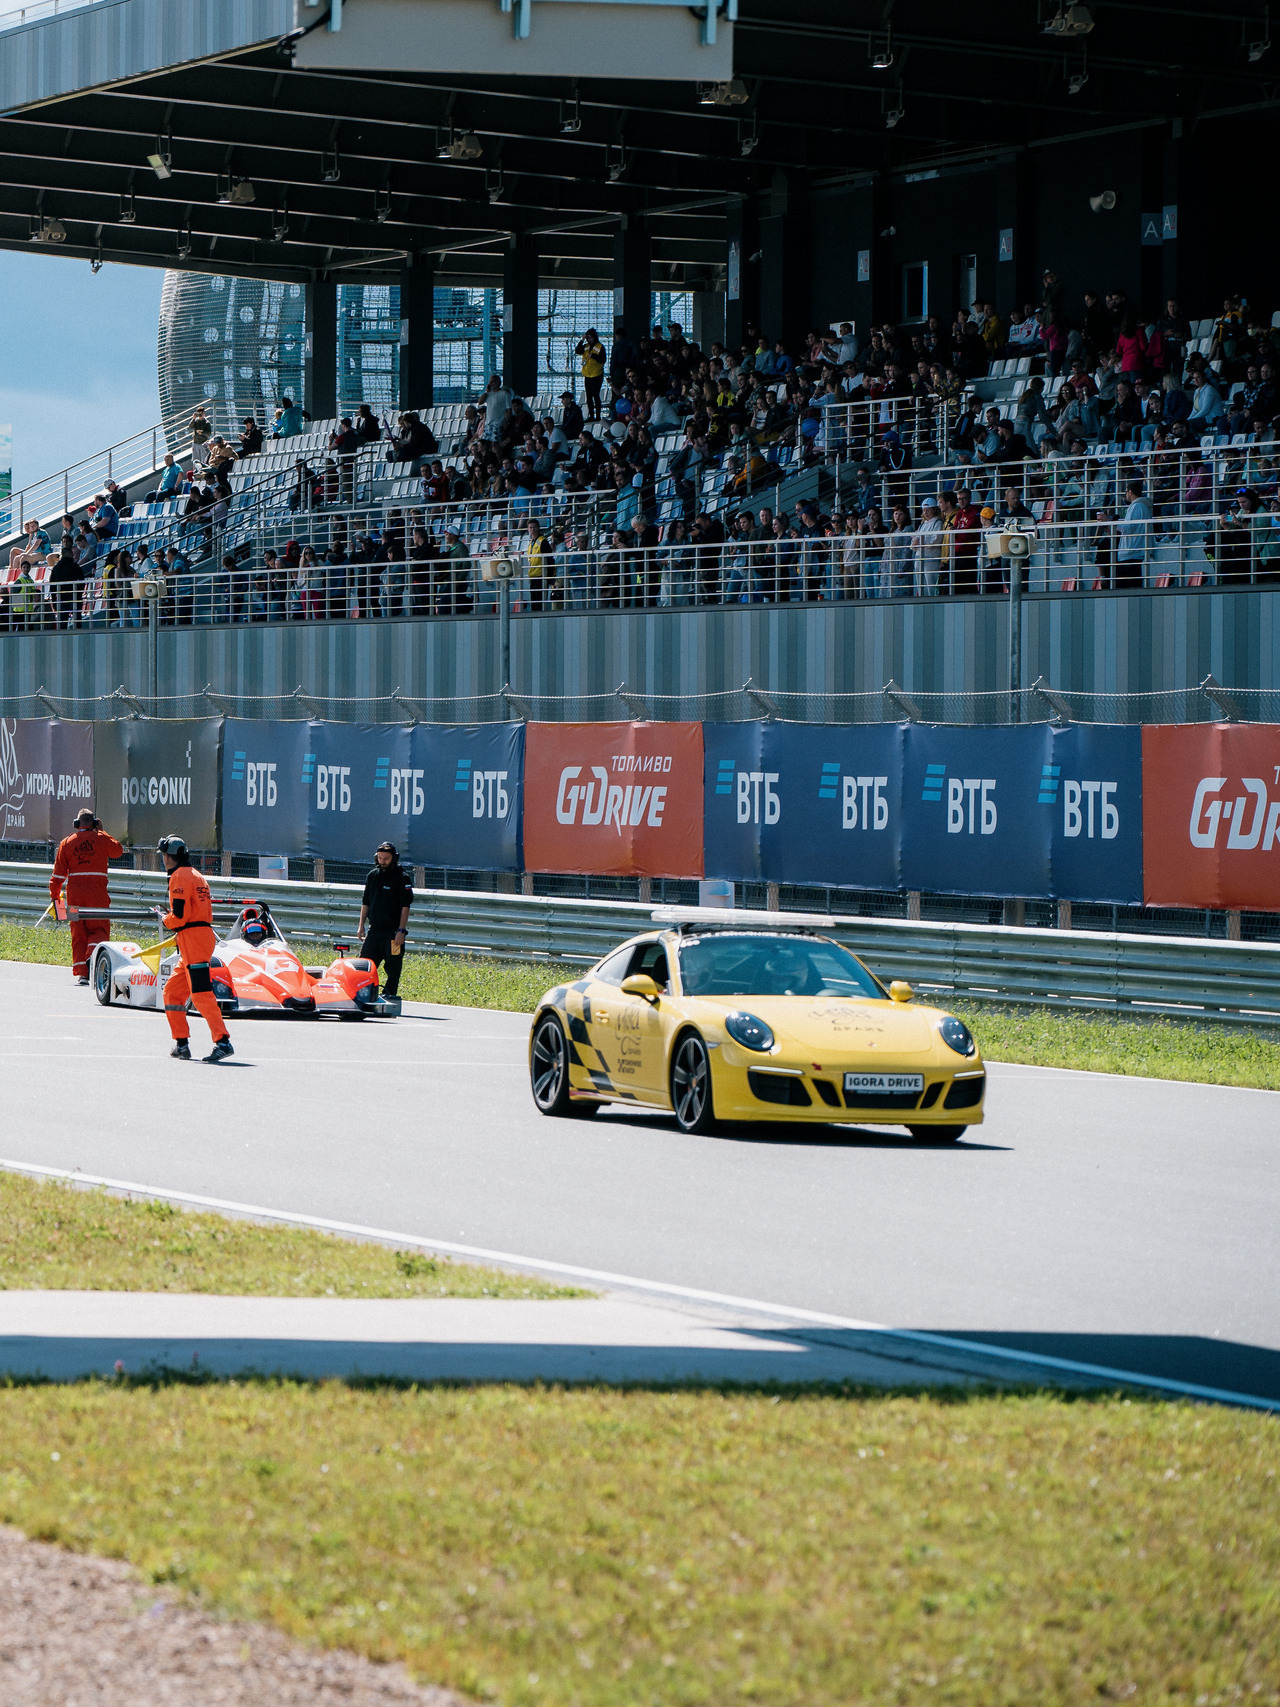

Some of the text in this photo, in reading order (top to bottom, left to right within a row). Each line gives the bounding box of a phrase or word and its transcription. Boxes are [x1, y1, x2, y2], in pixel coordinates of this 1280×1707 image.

[26, 770, 91, 800] ИГОРА ДРАЙВ
[246, 762, 277, 806] ВТБ
[612, 755, 672, 773] ТОПЛИВО
[122, 776, 191, 805] ROSGONKI
[317, 764, 351, 812] ВТБ
[390, 768, 425, 815] ВТБ
[473, 770, 509, 818] ВТБ
[737, 772, 781, 825] ВТБ
[842, 776, 888, 830] ВТБ
[947, 778, 997, 835] ВТБ
[1063, 780, 1119, 839] ВТБ
[6, 812, 25, 828] ДРАЙВ
[849, 1077, 920, 1088] IGORA DRIVE
